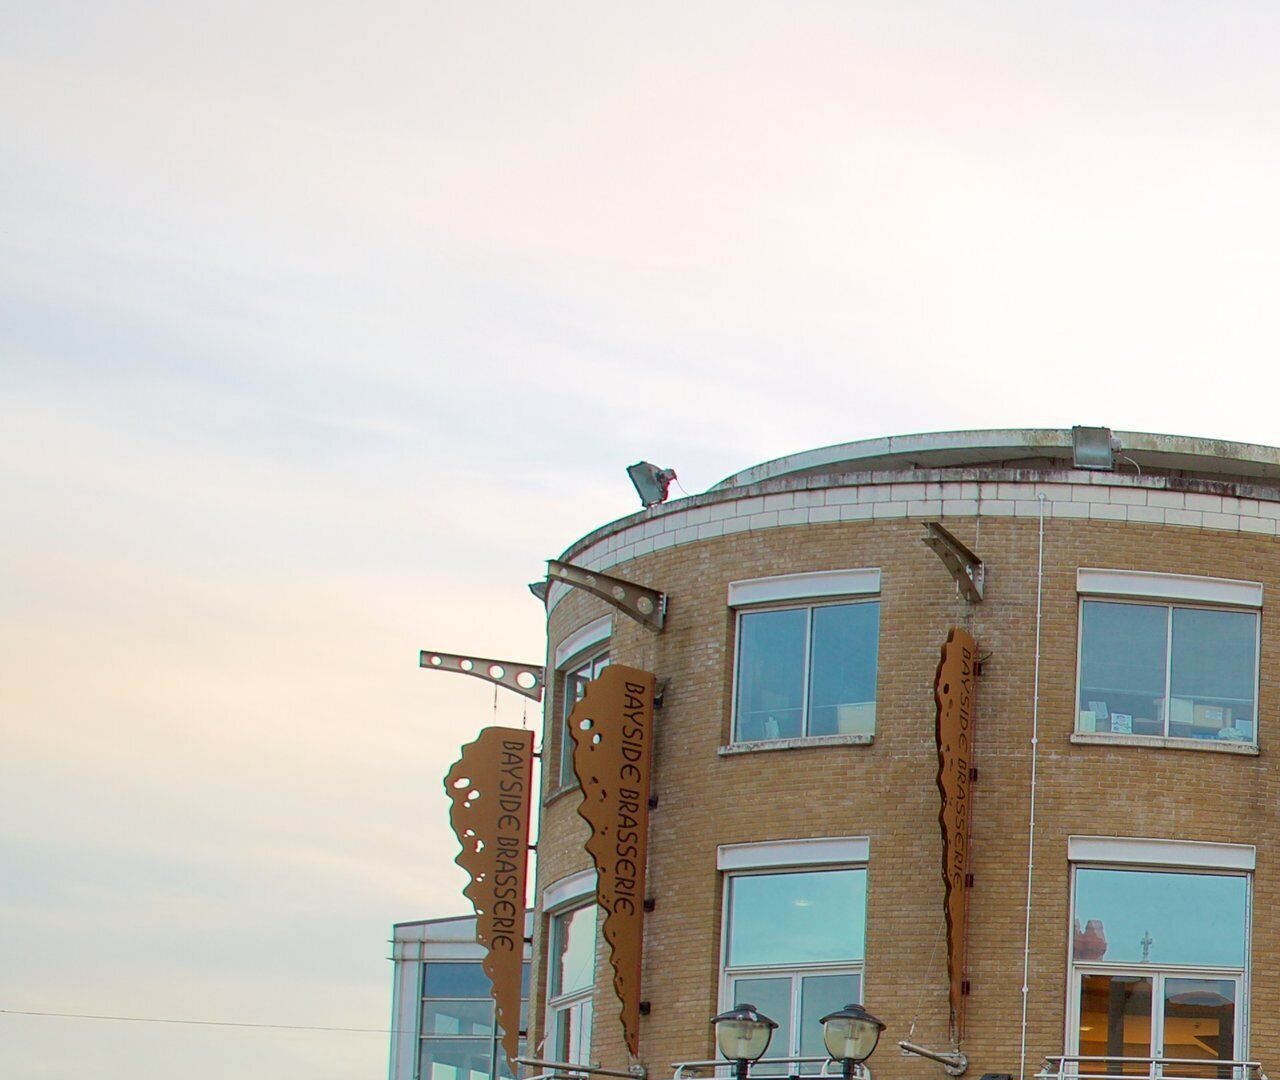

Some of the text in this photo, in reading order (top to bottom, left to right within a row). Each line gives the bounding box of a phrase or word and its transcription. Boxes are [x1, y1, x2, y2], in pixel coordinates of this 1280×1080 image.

[491, 740, 526, 952] BAYSIDE BRASSERIE
[613, 680, 646, 917] BAYSIDE BRASSERIE
